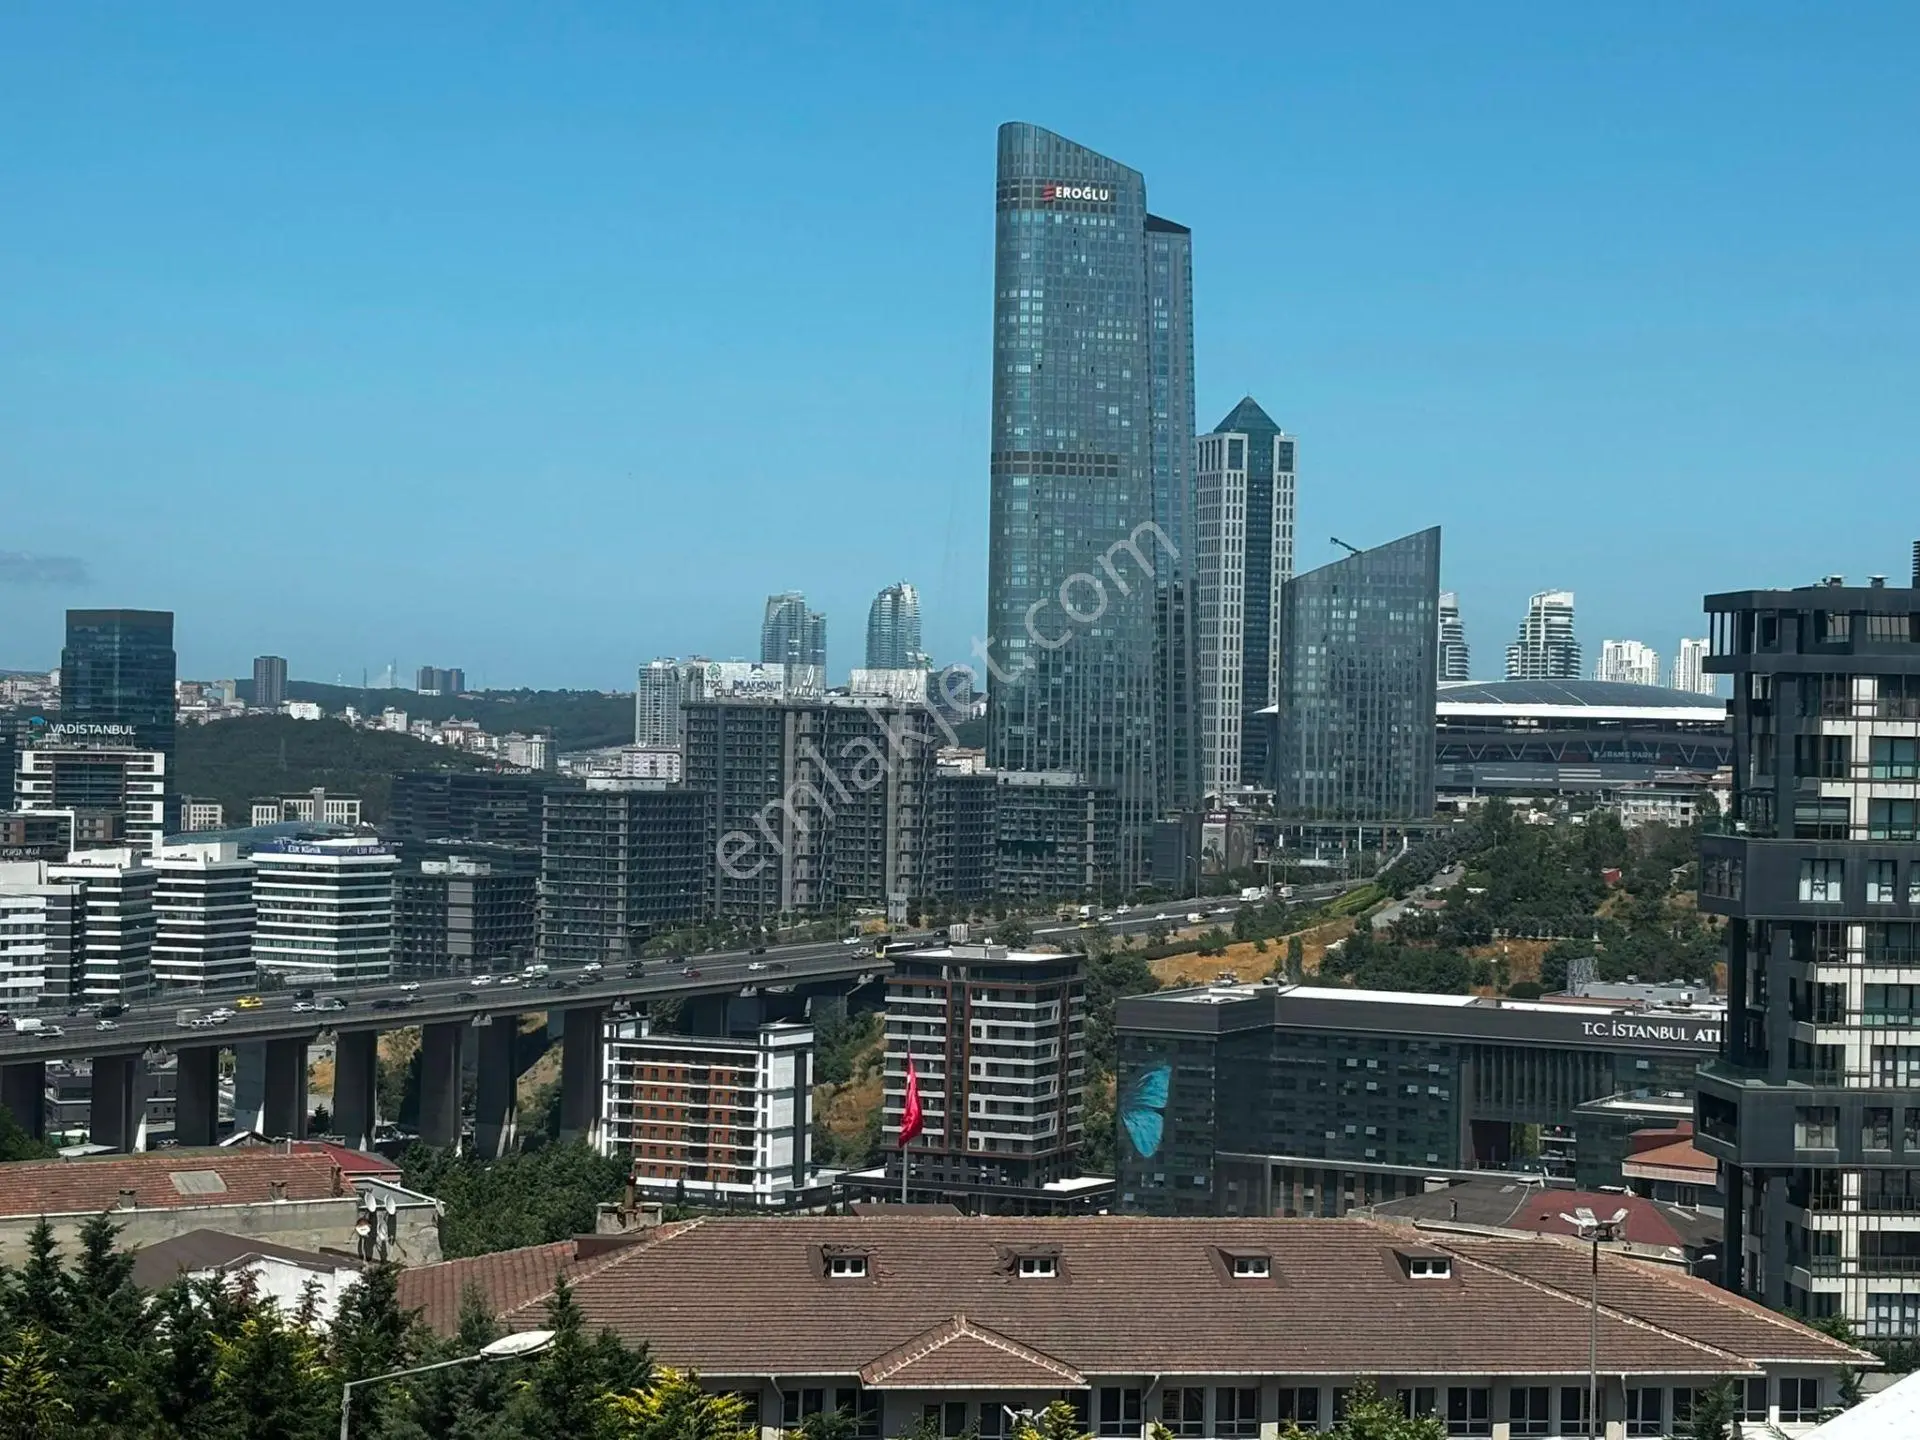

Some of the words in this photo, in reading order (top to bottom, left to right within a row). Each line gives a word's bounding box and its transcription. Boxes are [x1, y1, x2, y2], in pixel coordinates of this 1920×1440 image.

[1055, 186, 1109, 201] EROĞLU
[49, 721, 136, 735] VADİSTANBUL
[1582, 1021, 1609, 1036] T.C.
[1612, 1020, 1689, 1041] İSTANBUL
